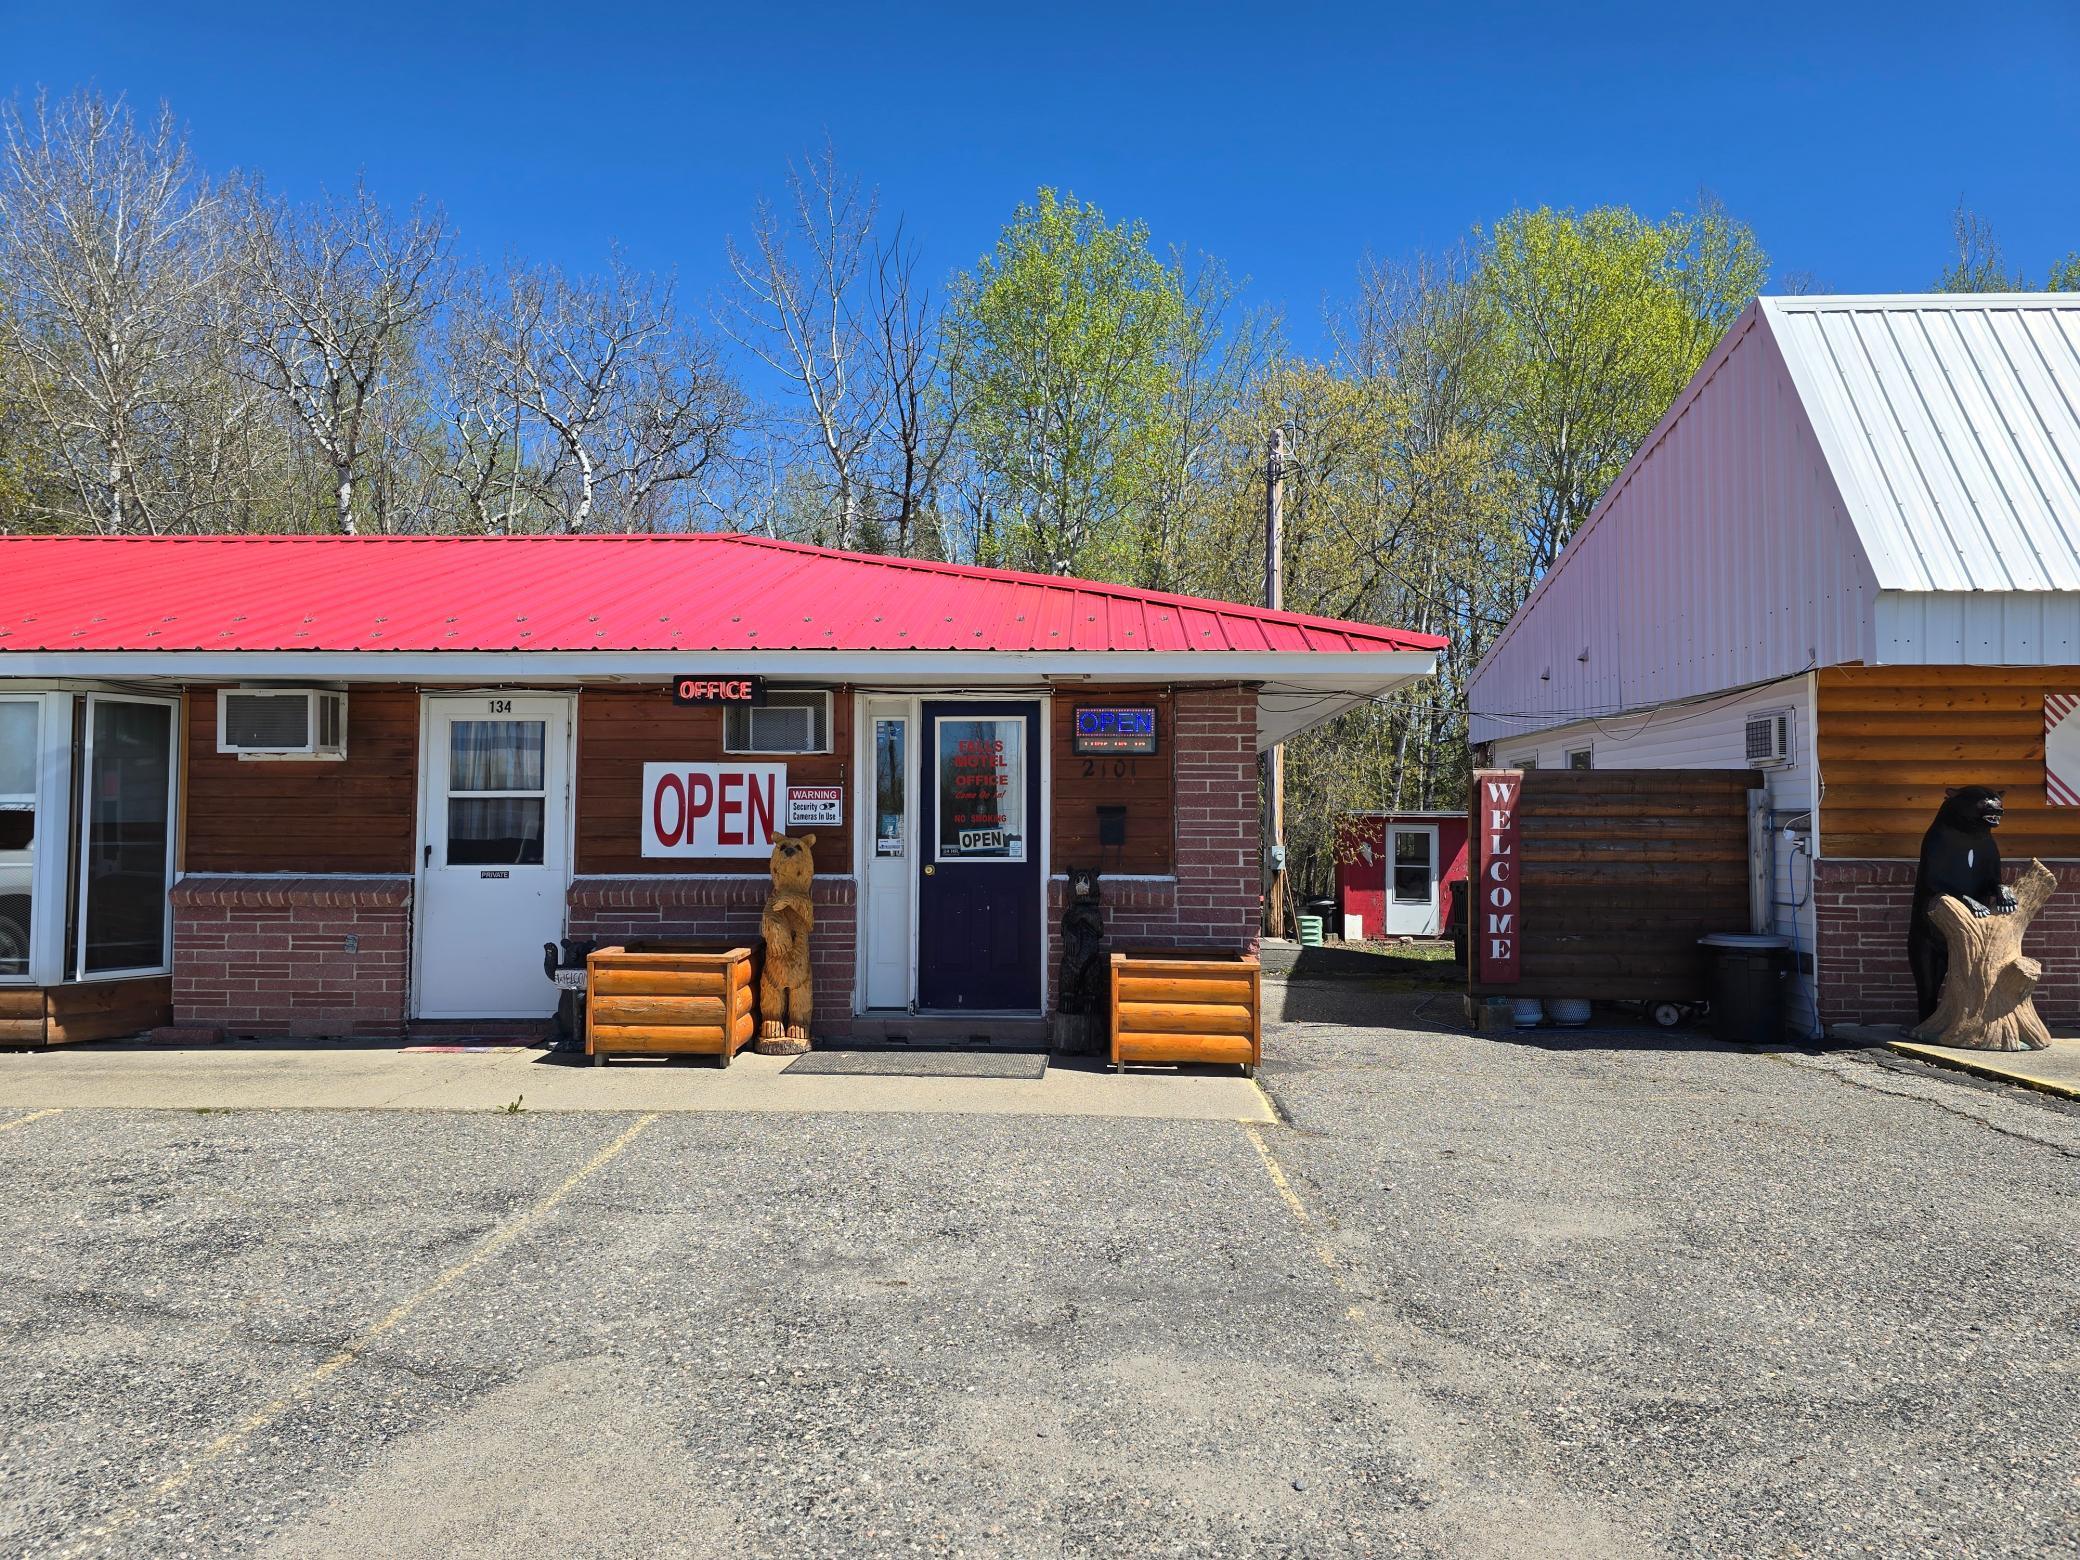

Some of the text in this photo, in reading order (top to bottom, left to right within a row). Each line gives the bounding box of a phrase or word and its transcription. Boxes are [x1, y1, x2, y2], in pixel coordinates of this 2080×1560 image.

[680, 681, 752, 700] OFFICE
[489, 700, 512, 713] 134
[1080, 712, 1151, 733] OPEN
[959, 740, 1004, 753] FALLS
[954, 755, 1008, 768] MOTEL
[1083, 759, 1136, 777] 2101
[955, 775, 1009, 787] OFFICE
[792, 790, 837, 799] WARNING
[653, 772, 776, 848] OPEN
[793, 802, 818, 812] Security
[793, 812, 836, 821] Cameras In Use
[954, 814, 1007, 824] NO SMOKING
[962, 831, 1001, 848] OPEN
[481, 871, 509, 879] PRIVATE
[1487, 782, 1515, 960] WELCOME
